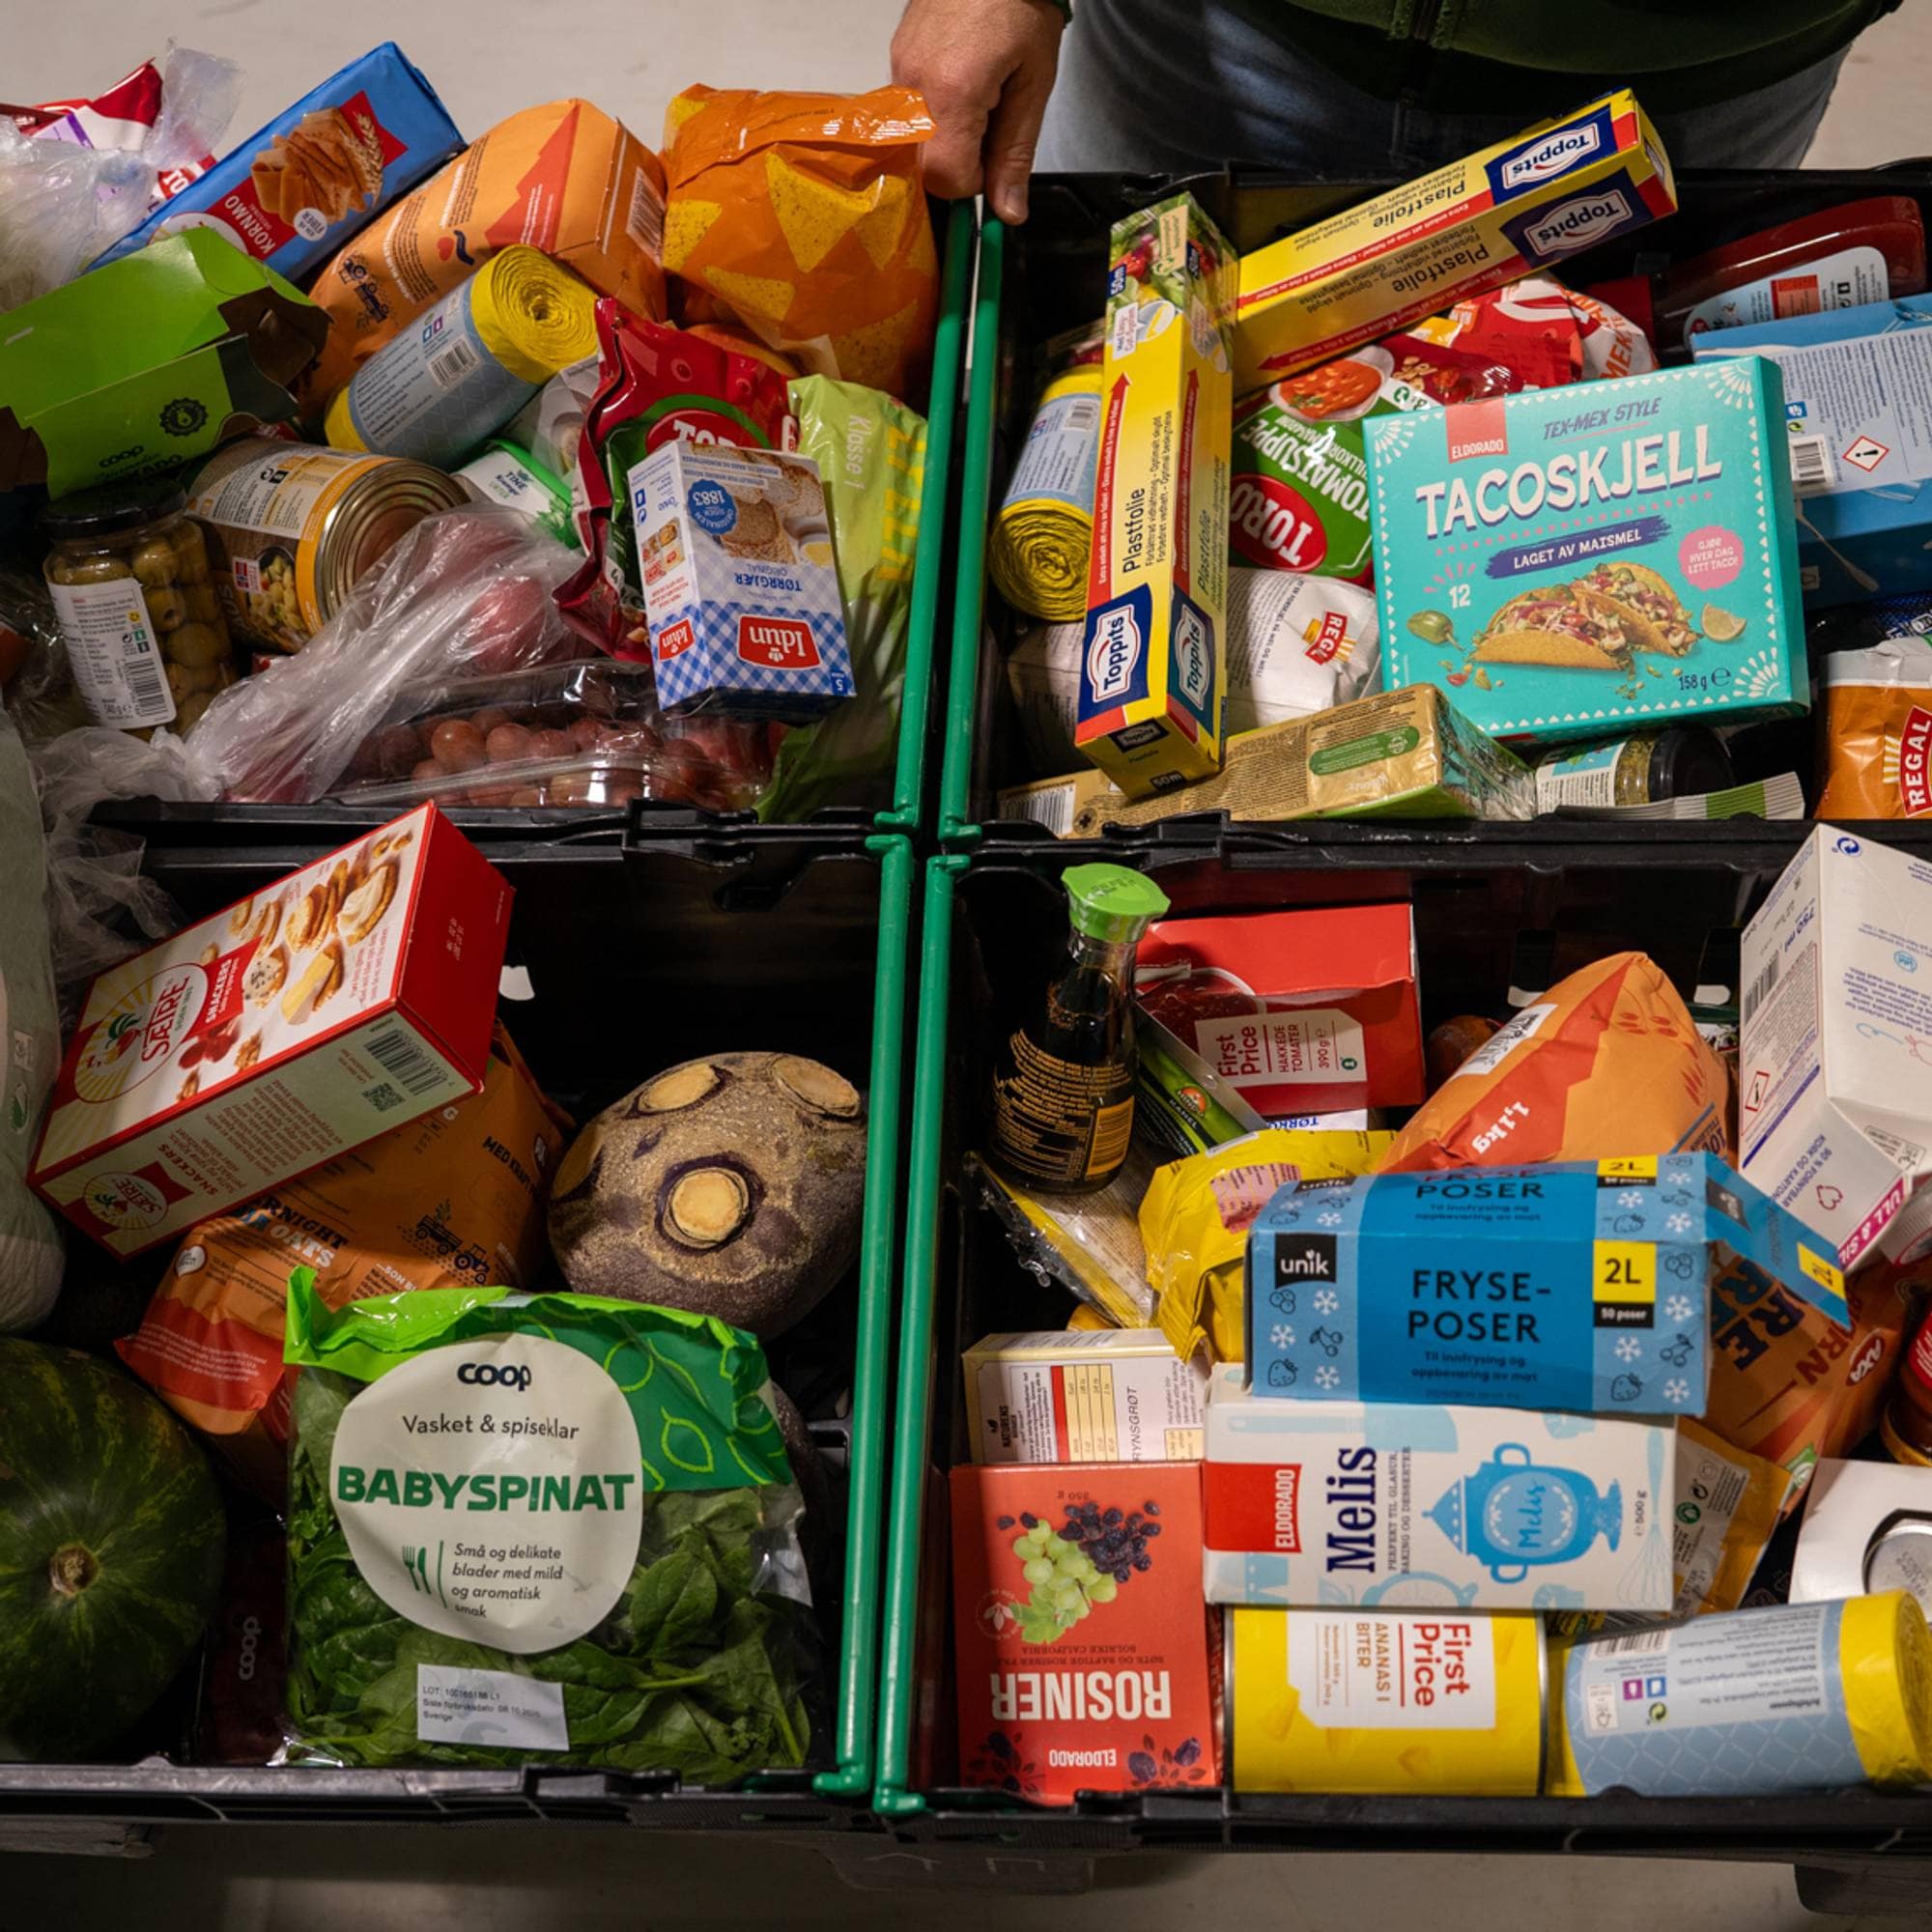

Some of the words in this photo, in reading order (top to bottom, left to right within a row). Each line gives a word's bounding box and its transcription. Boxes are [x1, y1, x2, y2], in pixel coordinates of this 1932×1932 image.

[1507, 129, 1593, 179] Toppits
[222, 191, 276, 257] KORNMO
[1367, 177, 1470, 231] Plastfolie
[1534, 195, 1619, 247] Toppits
[1390, 241, 1490, 297] Plastfolie
[1544, 410, 1610, 440] TEX-MEX
[1614, 398, 1662, 421] STYLE
[99, 445, 144, 468] coop
[842, 414, 874, 475] Klasse
[1451, 440, 1504, 459] ELDORADO
[1241, 417, 1371, 522] TOMATSUPPE
[1415, 425, 1722, 540] TACOSKJELL
[692, 485, 726, 508] 1883
[1122, 487, 1146, 573] Plastfolie
[1231, 479, 1313, 566] TORO
[1197, 510, 1211, 590] Plastfolie
[1514, 547, 1552, 569] LAGET
[1557, 543, 1577, 560] AV
[1579, 529, 1642, 555] MAISMEL
[1689, 551, 1714, 564] HVER
[1716, 547, 1734, 560] DAG
[732, 570, 803, 592] TØRRGJÆR
[1448, 583, 1472, 610] 12
[662, 624, 688, 648] Idun
[746, 622, 809, 658] Idun
[1104, 619, 1125, 690] Toppits
[1187, 623, 1202, 692] Toppits
[835, 678, 843, 691] 5
[1678, 675, 1697, 691] 158
[1698, 677, 1708, 692] g
[1906, 719, 1931, 807] REGAL
[205, 958, 232, 1024] SNACKERS
[142, 975, 189, 1062] SÆTRE
[1217, 1035, 1237, 1077] First
[1241, 1025, 1258, 1076] Price
[1273, 1024, 1292, 1072] HAKKEDE
[1287, 1024, 1304, 1071] TOMATER
[154, 1143, 220, 1195] SNACKERS
[480, 1132, 514, 1166] MED
[1609, 1162, 1645, 1172] 2L
[121, 1178, 163, 1216] SÆTRE
[1416, 1183, 1545, 1200] POSER
[1869, 1185, 1905, 1227] ULL
[266, 1219, 338, 1270] OATS
[1281, 1250, 1329, 1275] unik
[1413, 1270, 1551, 1302] FRYSE-
[1605, 1259, 1641, 1285] 2L
[1407, 1311, 1541, 1344] POSER
[1601, 1309, 1613, 1320] 50
[1615, 1309, 1648, 1322] poser
[458, 1363, 531, 1391] coop
[1411, 1368, 1490, 1381] oppbevaring
[1493, 1371, 1508, 1380] av
[1512, 1371, 1538, 1382] mat
[1425, 1350, 1439, 1363] Til
[1442, 1351, 1508, 1368] innfrysing
[1511, 1355, 1526, 1368] og
[402, 1413, 472, 1434] Vasket
[480, 1414, 495, 1433] &
[501, 1416, 580, 1440] spiseklar
[1000, 1406, 1010, 1447] NATURENS
[1126, 1386, 1141, 1460] RYNSGRØT
[337, 1465, 635, 1512] BABYSPINAT
[1400, 1446, 1410, 1512] DESSERTER
[1275, 1470, 1295, 1548] ELDORADO
[1327, 1446, 1378, 1574] Melis
[1387, 1501, 1397, 1519] TIL
[1401, 1515, 1410, 1530] OG
[1519, 1480, 1546, 1548] Melis
[454, 1544, 486, 1559] Små
[489, 1547, 506, 1562] og
[509, 1545, 561, 1561] delikate
[1387, 1522, 1397, 1571] PERFEKT
[1401, 1533, 1410, 1574] BAKING
[451, 1584, 470, 1601] og
[473, 1584, 541, 1601] aromatisk
[452, 1564, 498, 1578] blader
[502, 1565, 530, 1579] med
[533, 1565, 563, 1579] mild
[454, 1603, 488, 1619] smak
[238, 1614, 262, 1683] coop
[1021, 1644, 1086, 1654] CALIFORNIA
[1355, 1622, 1372, 1667] BITER
[1374, 1622, 1390, 1690] ANANAS
[1413, 1623, 1435, 1707] Price
[1444, 1623, 1470, 1695] First
[421, 1710, 452, 1722] Sverige
[990, 1670, 1172, 1720] ROSINER
[1049, 1748, 1117, 1767] ELDORADO
